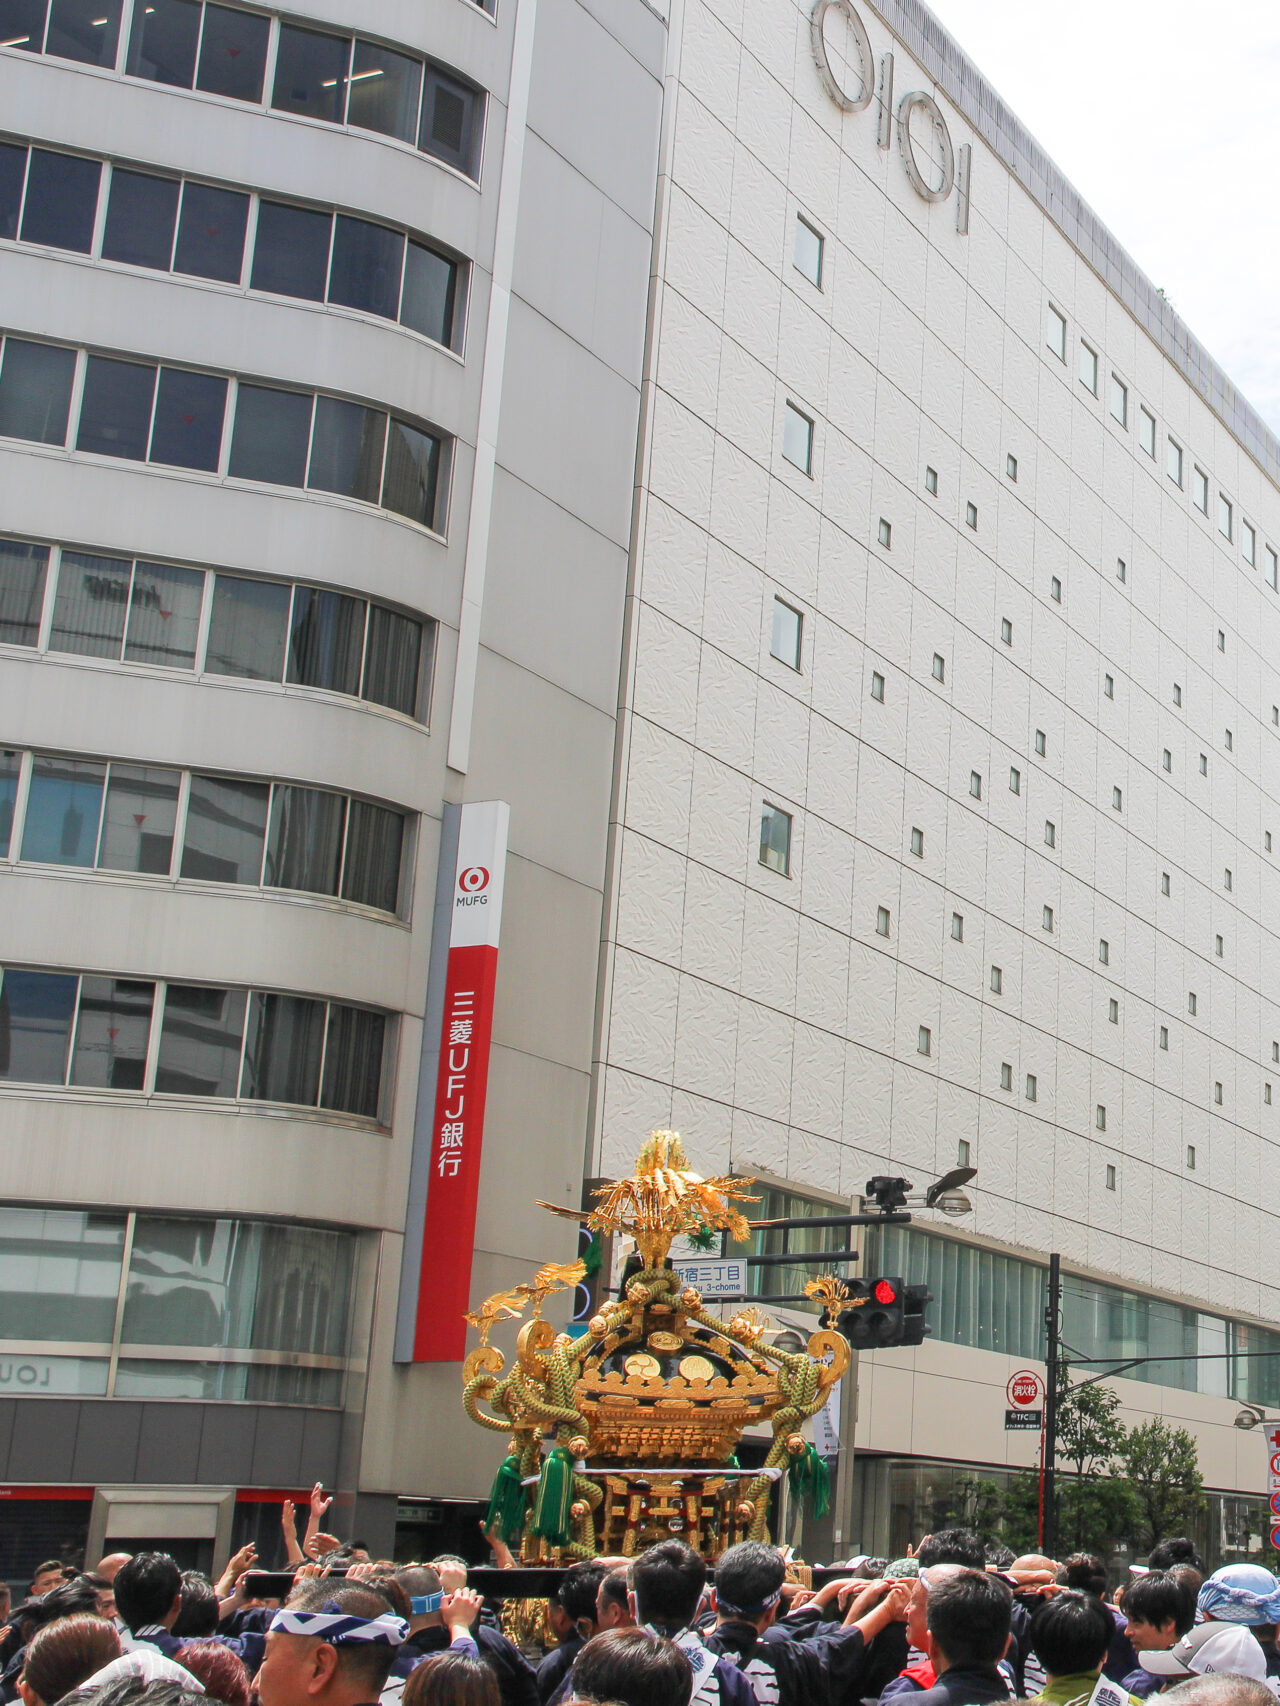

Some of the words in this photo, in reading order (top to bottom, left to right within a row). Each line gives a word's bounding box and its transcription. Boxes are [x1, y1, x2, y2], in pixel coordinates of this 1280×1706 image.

[456, 895, 488, 907] MUFG
[437, 990, 476, 1177] 三菱UFJ銀行
